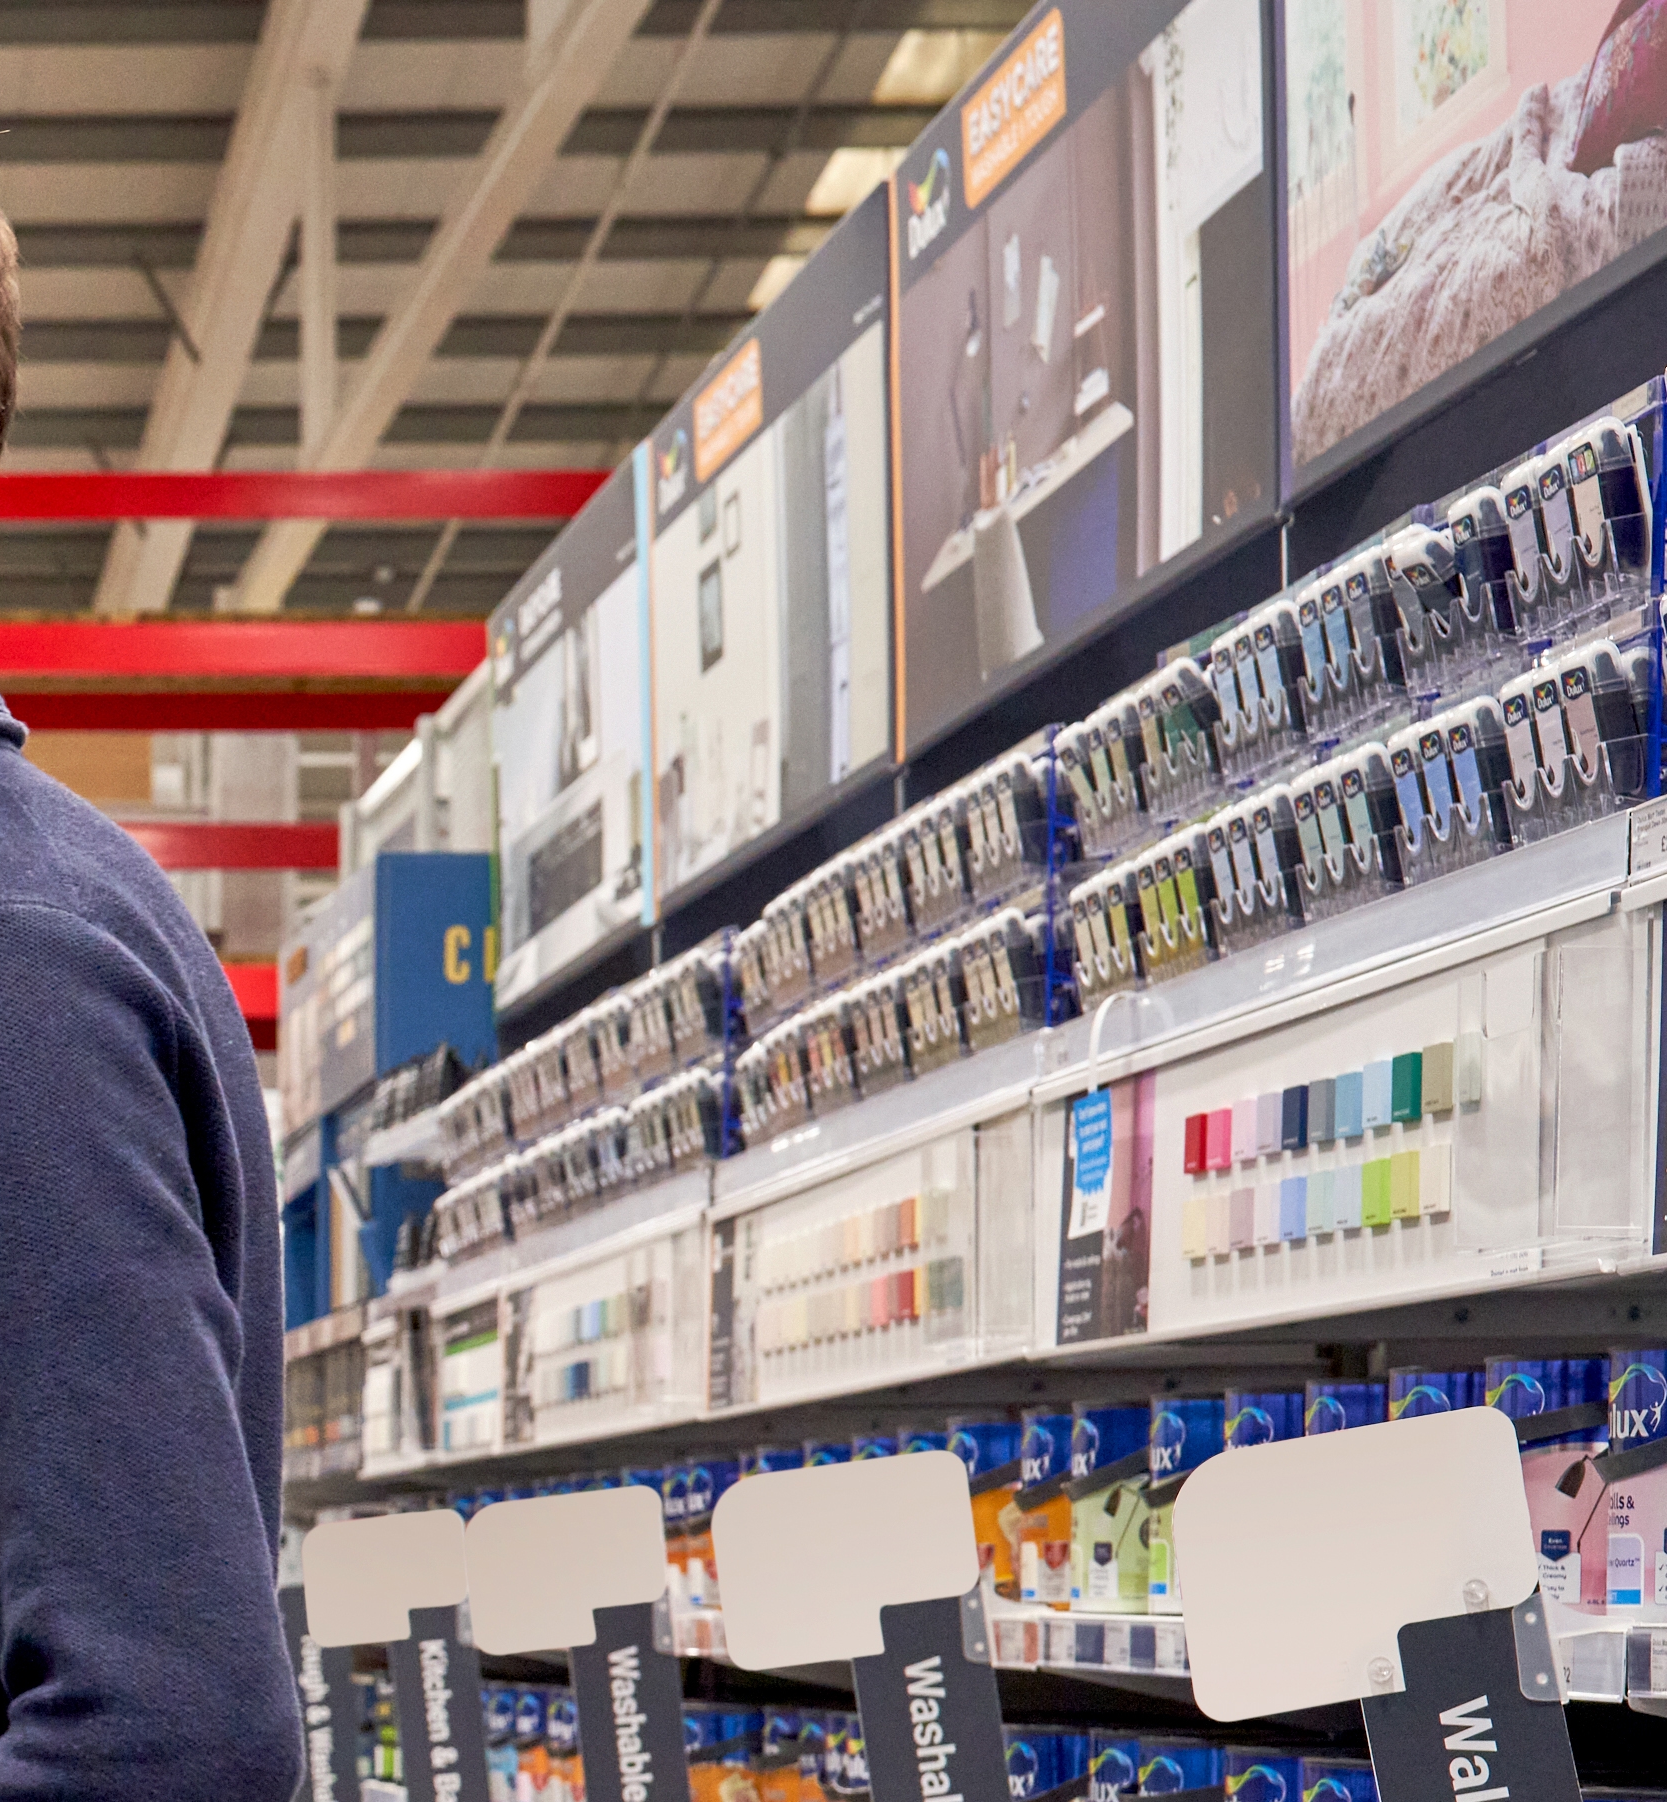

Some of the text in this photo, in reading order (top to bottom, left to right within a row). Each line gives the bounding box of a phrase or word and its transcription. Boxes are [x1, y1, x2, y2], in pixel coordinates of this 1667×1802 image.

[968, 22, 1060, 157] EASYCARE
[1542, 481, 1561, 500] Dulux
[1509, 503, 1528, 519] Dulux
[1567, 680, 1586, 700] Dulux
[1536, 694, 1554, 712] Dulux
[1507, 710, 1525, 726] Dulux
[1608, 1403, 1649, 1439] lux
[1626, 1495, 1635, 1510] &
[419, 1639, 453, 1742] Kitchen
[607, 1645, 654, 1802] Washable
[430, 1746, 459, 1769] &
